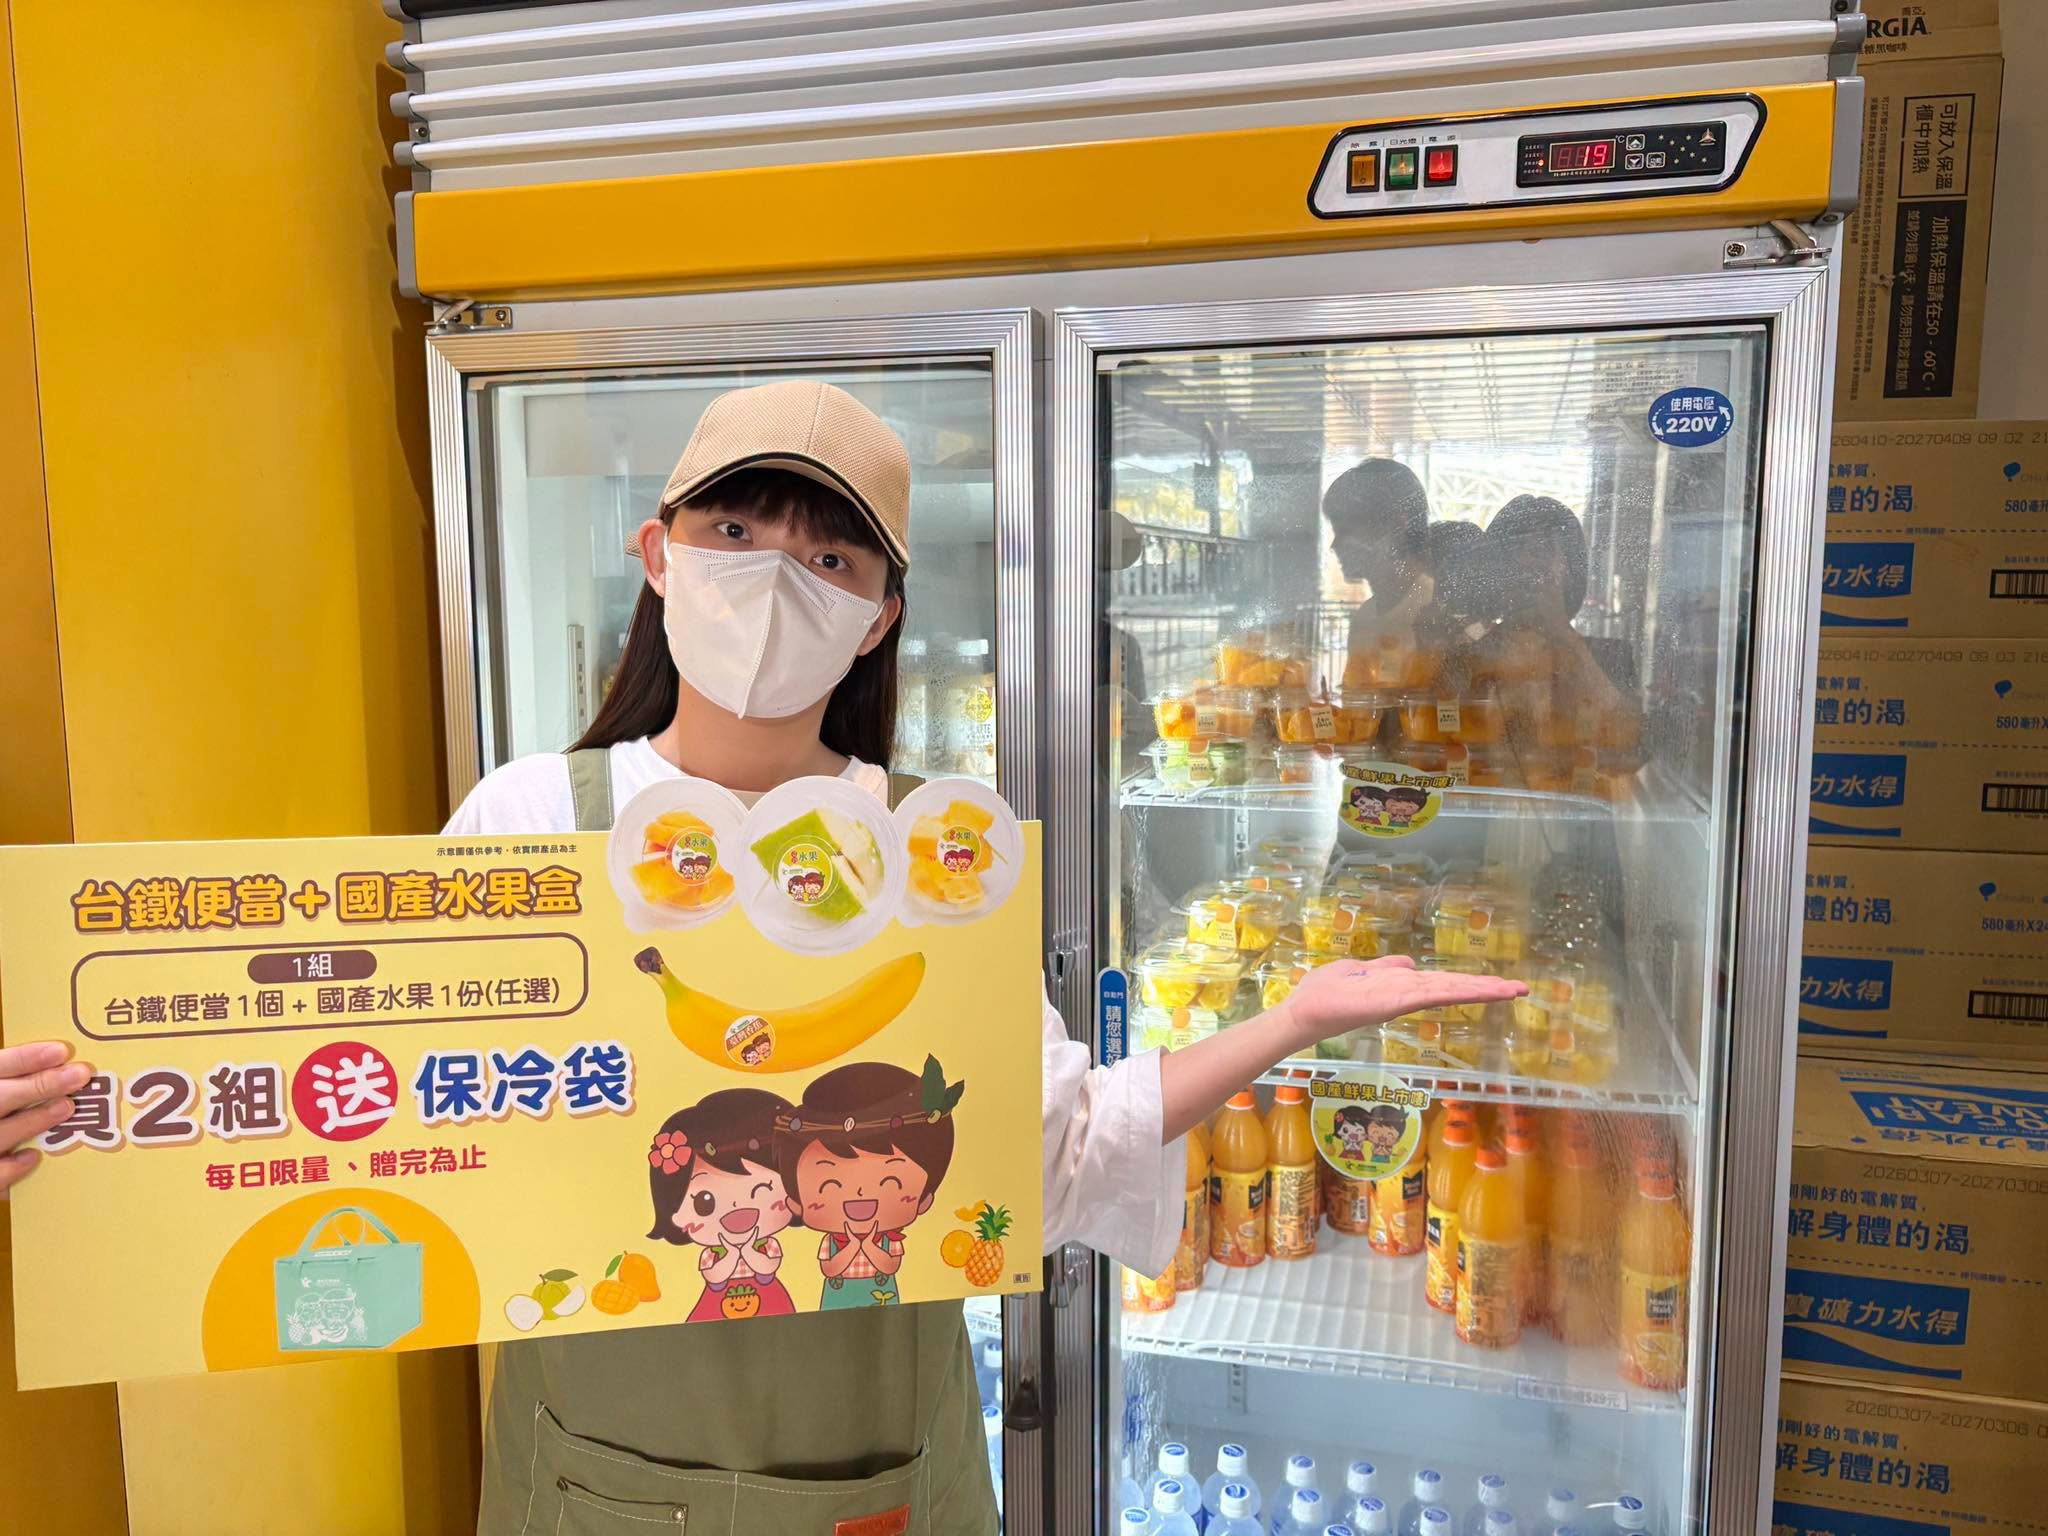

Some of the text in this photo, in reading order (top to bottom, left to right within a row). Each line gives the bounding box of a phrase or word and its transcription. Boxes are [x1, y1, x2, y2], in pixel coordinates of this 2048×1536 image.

[1866, 17, 1927, 38] RGIA
[1912, 104, 1934, 174] 櫃中加熱
[1936, 102, 1959, 190] 可放入保溫
[1670, 396, 1716, 412] 使用電壓
[1666, 416, 1718, 433] 220V
[1810, 774, 1898, 798] 力水得
[71, 865, 582, 933] 台鐵便當+國產水果盒
[291, 953, 334, 979] 1組
[1800, 976, 1885, 1002] 力水得
[204, 1145, 487, 1190] 每日限量、贈完為止
